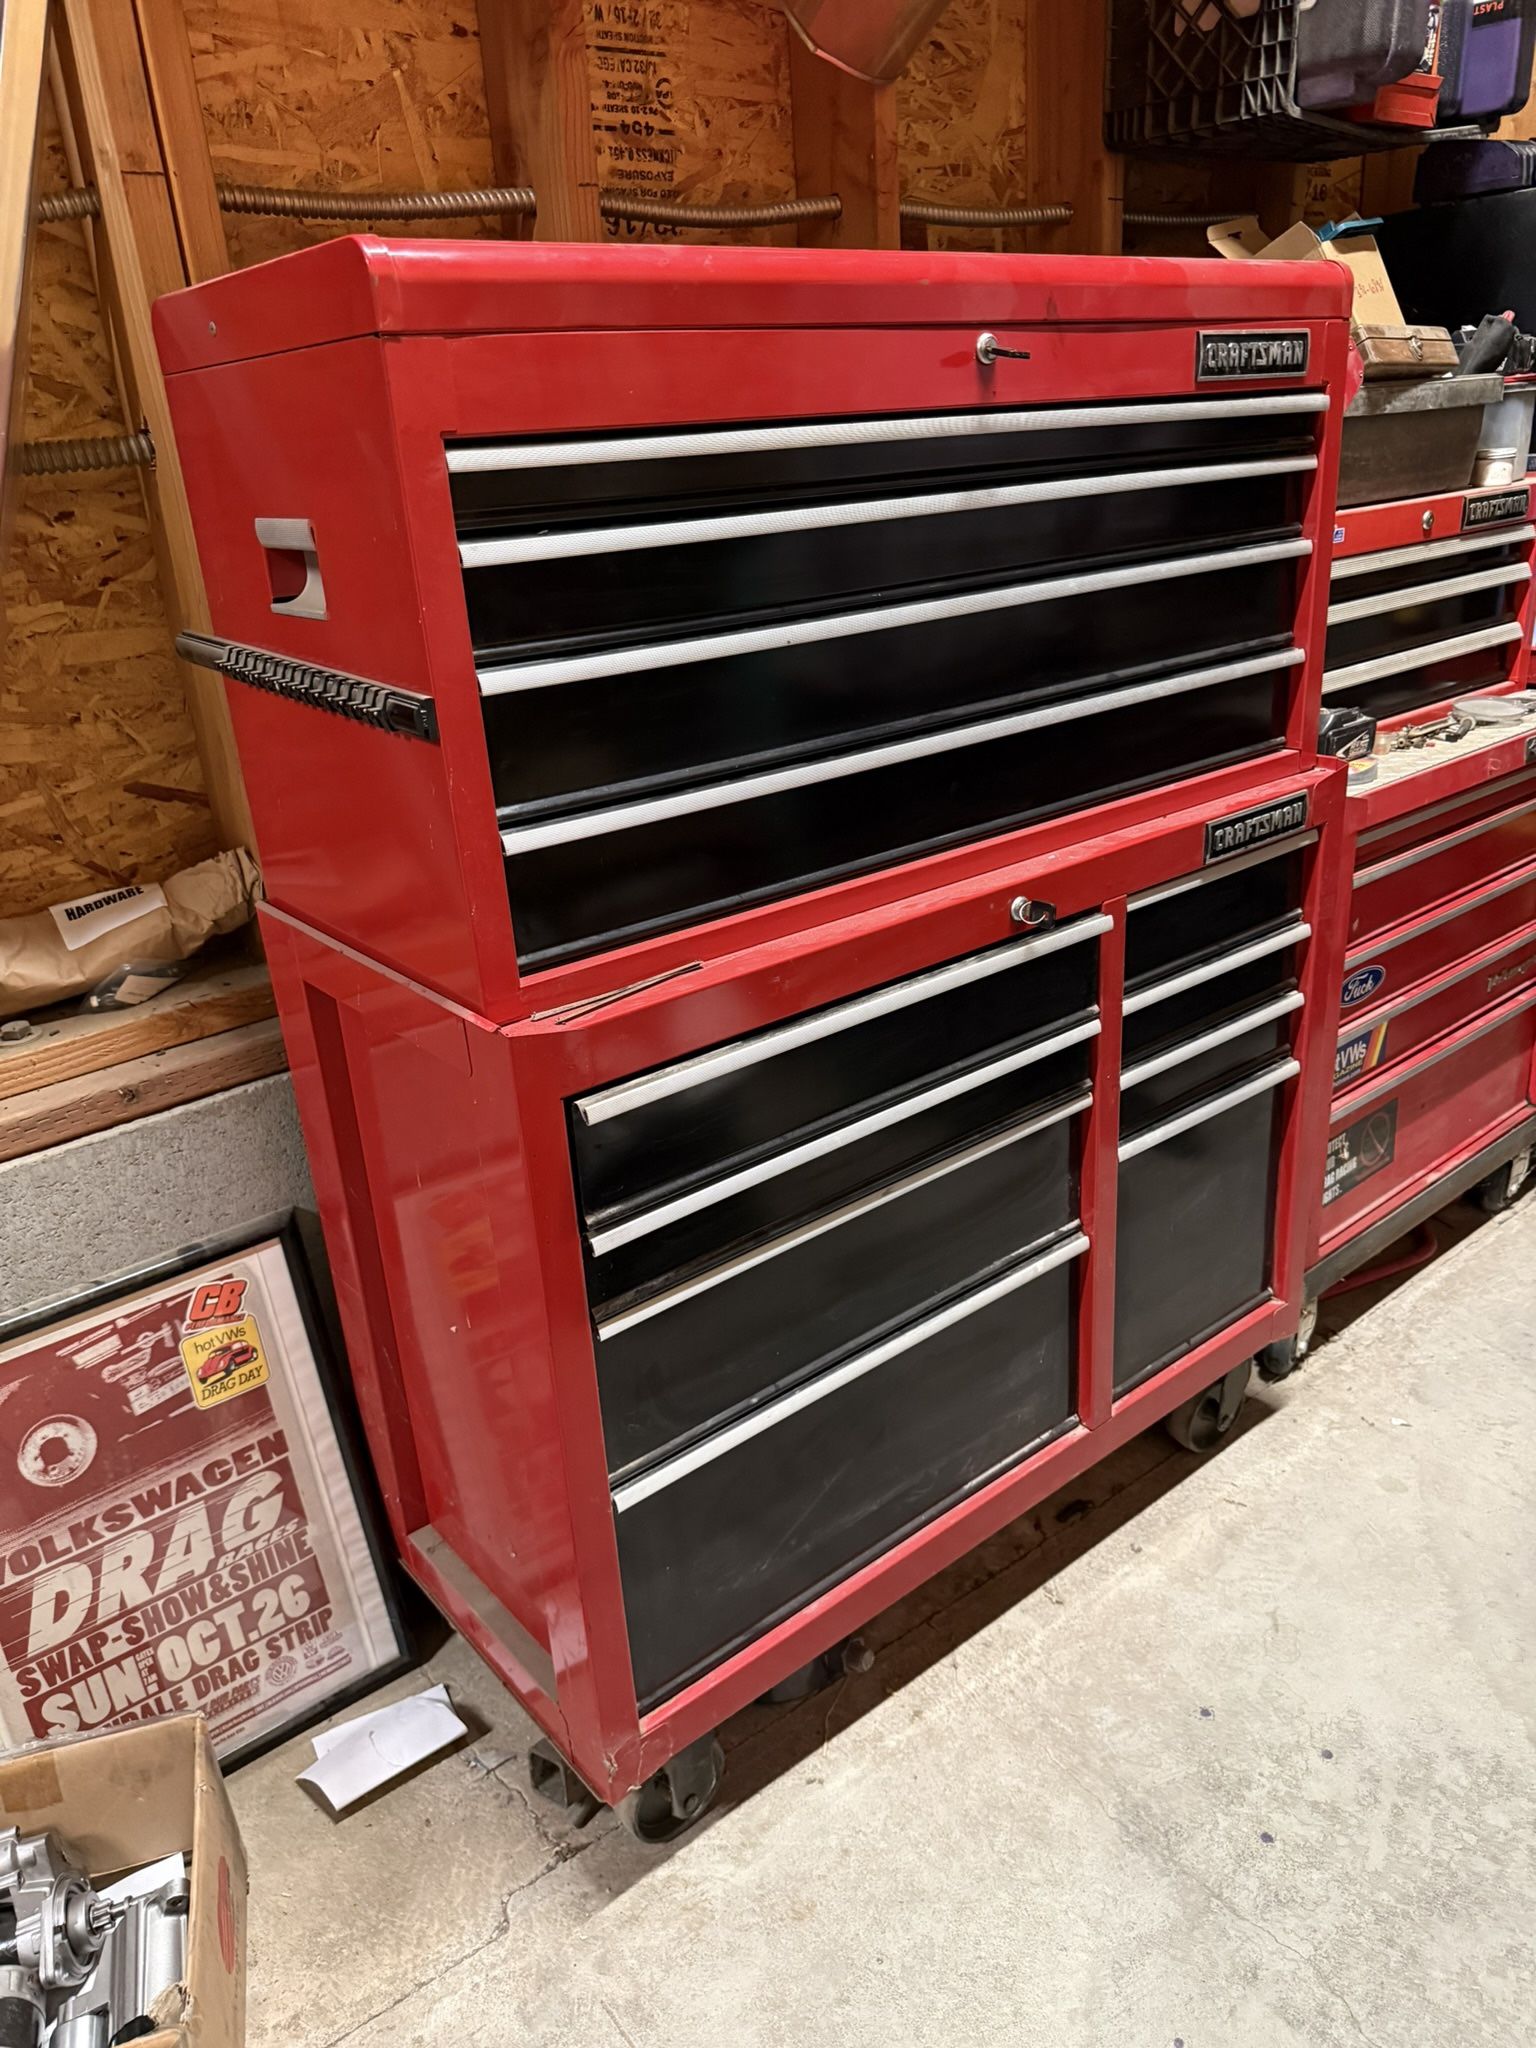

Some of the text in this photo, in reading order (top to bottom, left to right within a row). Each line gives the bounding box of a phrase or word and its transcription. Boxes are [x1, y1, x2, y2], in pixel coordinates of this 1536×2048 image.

[617, 168, 675, 183] EXPOSURE
[1206, 341, 1304, 368] CRAFTSMAN
[1470, 494, 1528, 521] CRAFTSMAN
[1214, 801, 1304, 851] CRAFTSMAN
[64, 886, 144, 921] HARDWARE
[189, 1280, 248, 1322] CB
[201, 1376, 237, 1402] DRAG
[238, 1364, 264, 1386] DAY
[217, 1518, 300, 1568] RACES
[27, 1470, 284, 1659] DRAG
[192, 1648, 260, 1700] DRAG
[265, 1607, 333, 1659] STRIP
